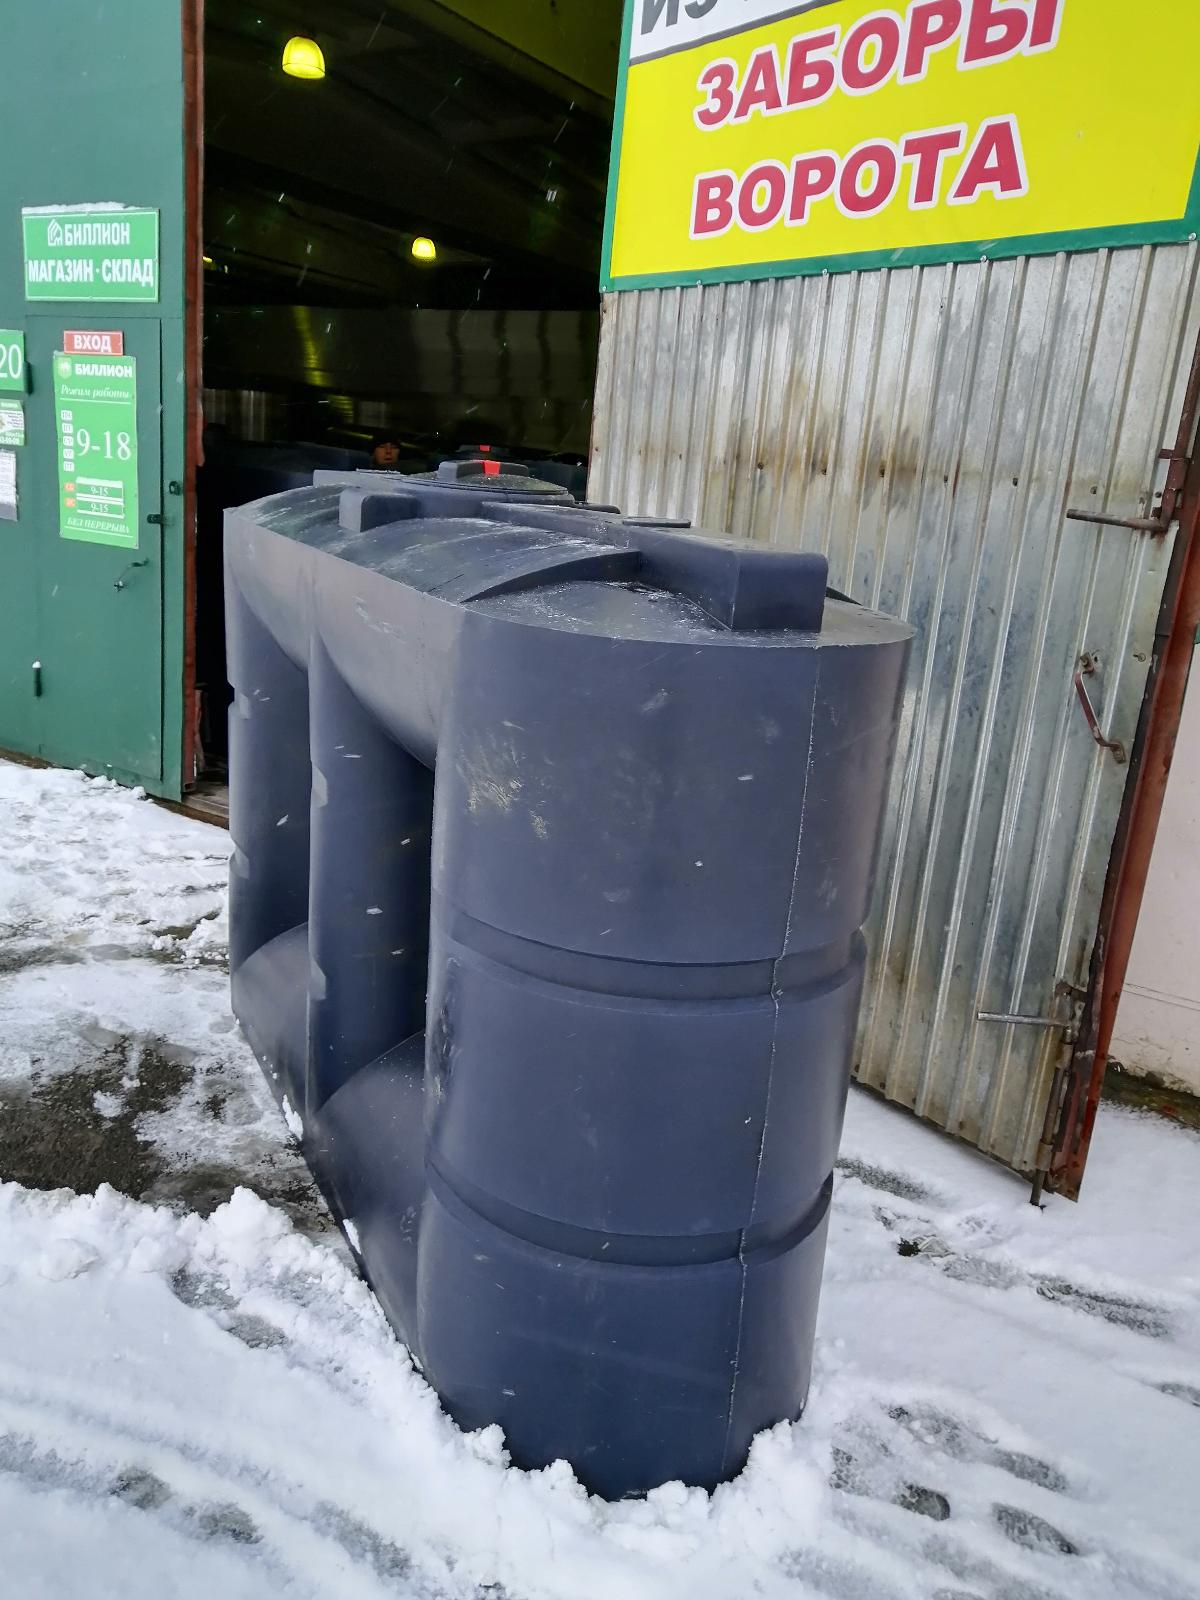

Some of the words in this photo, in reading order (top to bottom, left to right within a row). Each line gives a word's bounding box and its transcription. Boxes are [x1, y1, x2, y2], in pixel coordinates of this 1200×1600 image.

[696, 0, 1060, 127] ЗАБОРЫ
[693, 121, 1024, 235] ВОРОТА
[64, 222, 131, 246] БИЛЛИОН
[73, 334, 112, 353] ВХОД
[75, 363, 133, 378] БИЛЛИОН
[60, 384, 90, 396] Режим
[92, 387, 130, 399] работы
[76, 428, 132, 461] 9-18
[90, 487, 109, 496] 9-15
[90, 503, 109, 513] 9-15
[84, 519, 130, 534] ПЕРЕРЫВА
